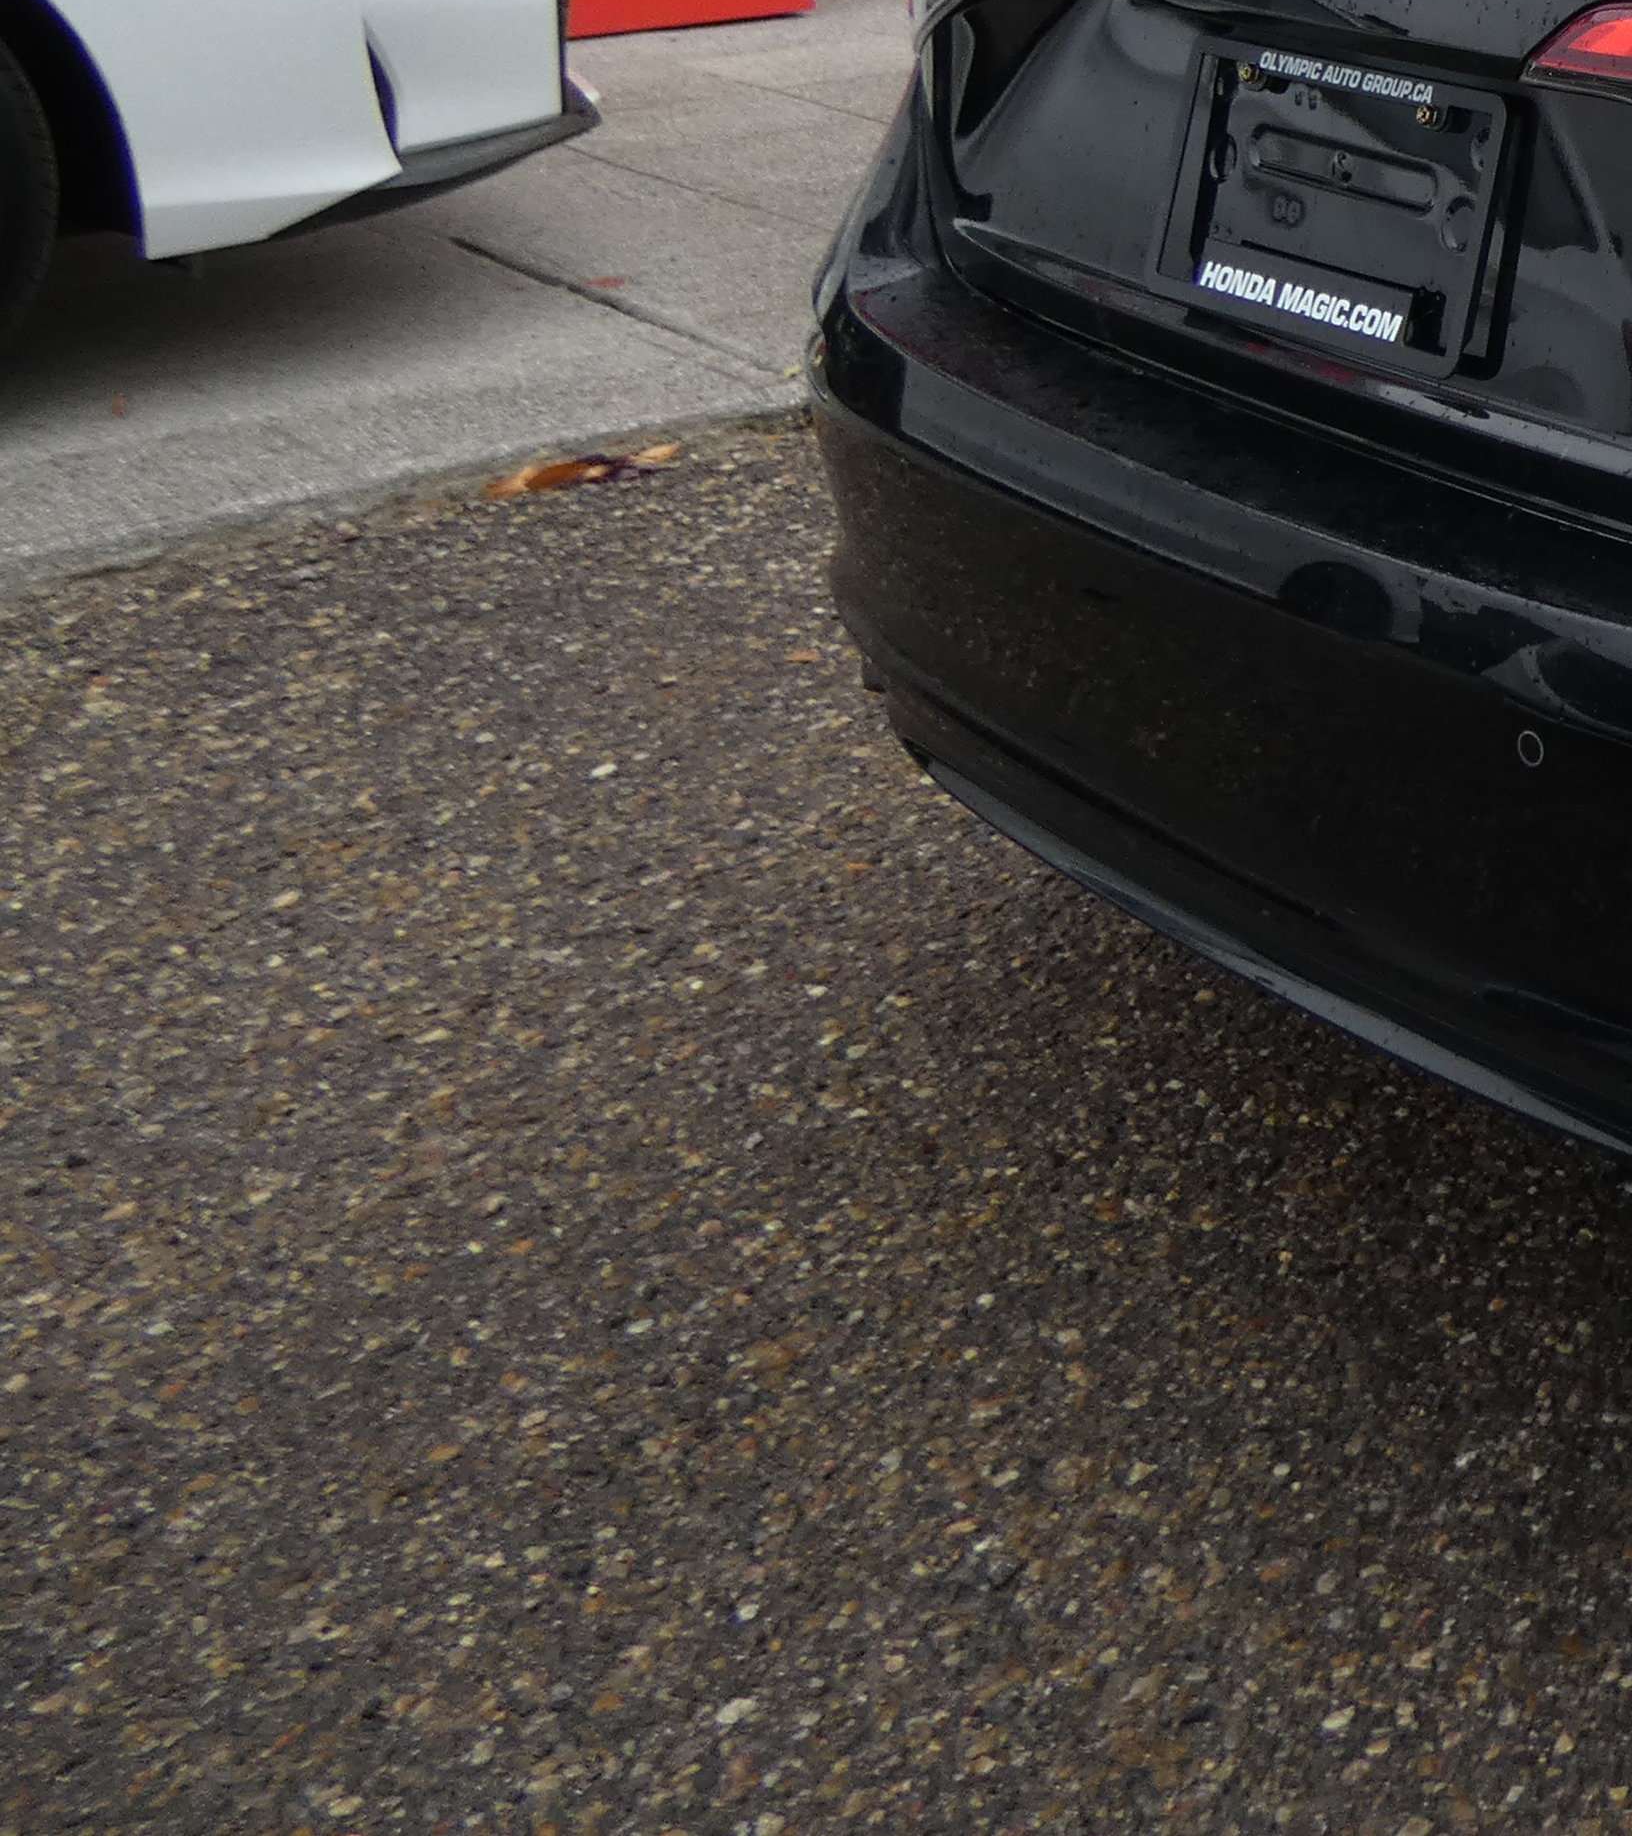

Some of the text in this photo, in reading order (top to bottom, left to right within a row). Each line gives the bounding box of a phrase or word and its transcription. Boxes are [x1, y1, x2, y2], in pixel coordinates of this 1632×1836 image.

[1259, 51, 1434, 104] OLYMPIC AUTO GROUP.CA
[1200, 261, 1403, 342] HONDA MAGIC.COM
